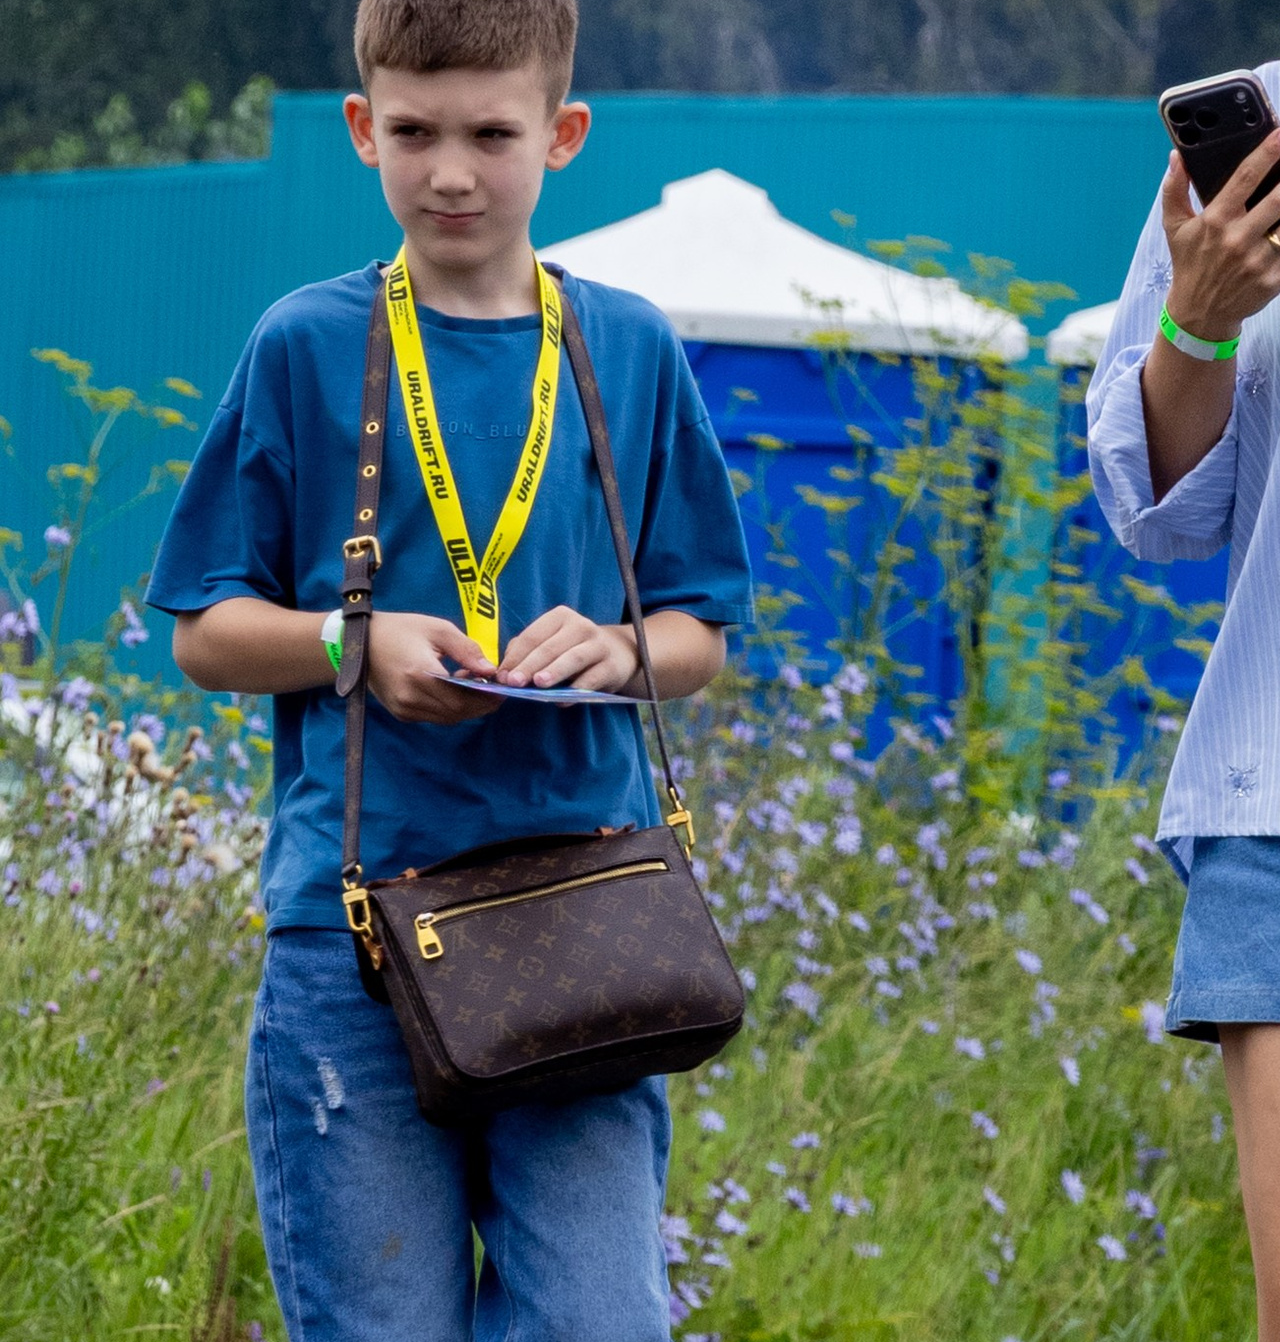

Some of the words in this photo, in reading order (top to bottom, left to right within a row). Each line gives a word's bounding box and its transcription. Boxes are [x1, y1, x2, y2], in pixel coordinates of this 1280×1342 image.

[389, 263, 408, 302] ULD
[545, 301, 560, 350] ULD
[396, 420, 529, 441] BTON_BLU
[406, 370, 449, 500] URALDRIFT.RU
[516, 378, 551, 504] URALDRIFT.RU
[446, 538, 477, 583] ULD
[476, 571, 495, 620] ULD
